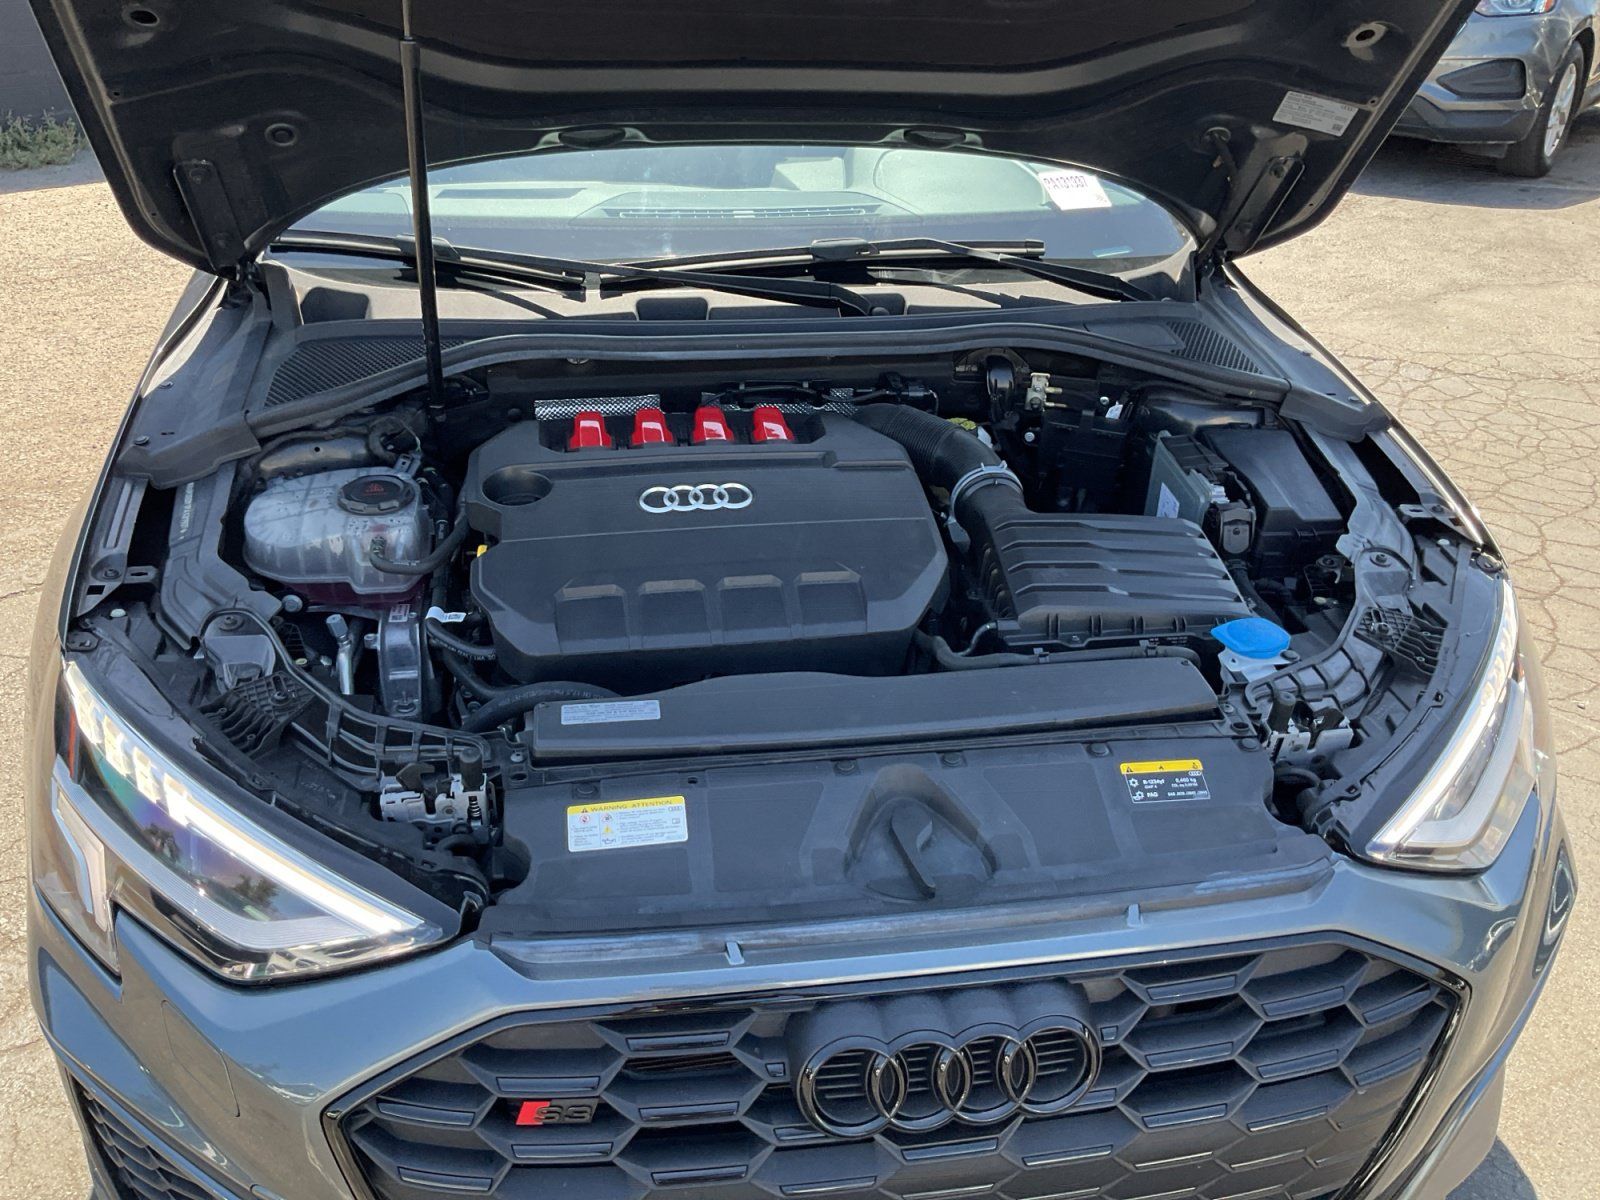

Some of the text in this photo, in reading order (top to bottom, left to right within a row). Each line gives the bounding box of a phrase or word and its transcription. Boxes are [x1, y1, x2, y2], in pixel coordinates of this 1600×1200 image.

[591, 800, 672, 812] WARNING ATTENTION
[534, 1104, 592, 1122] S3
